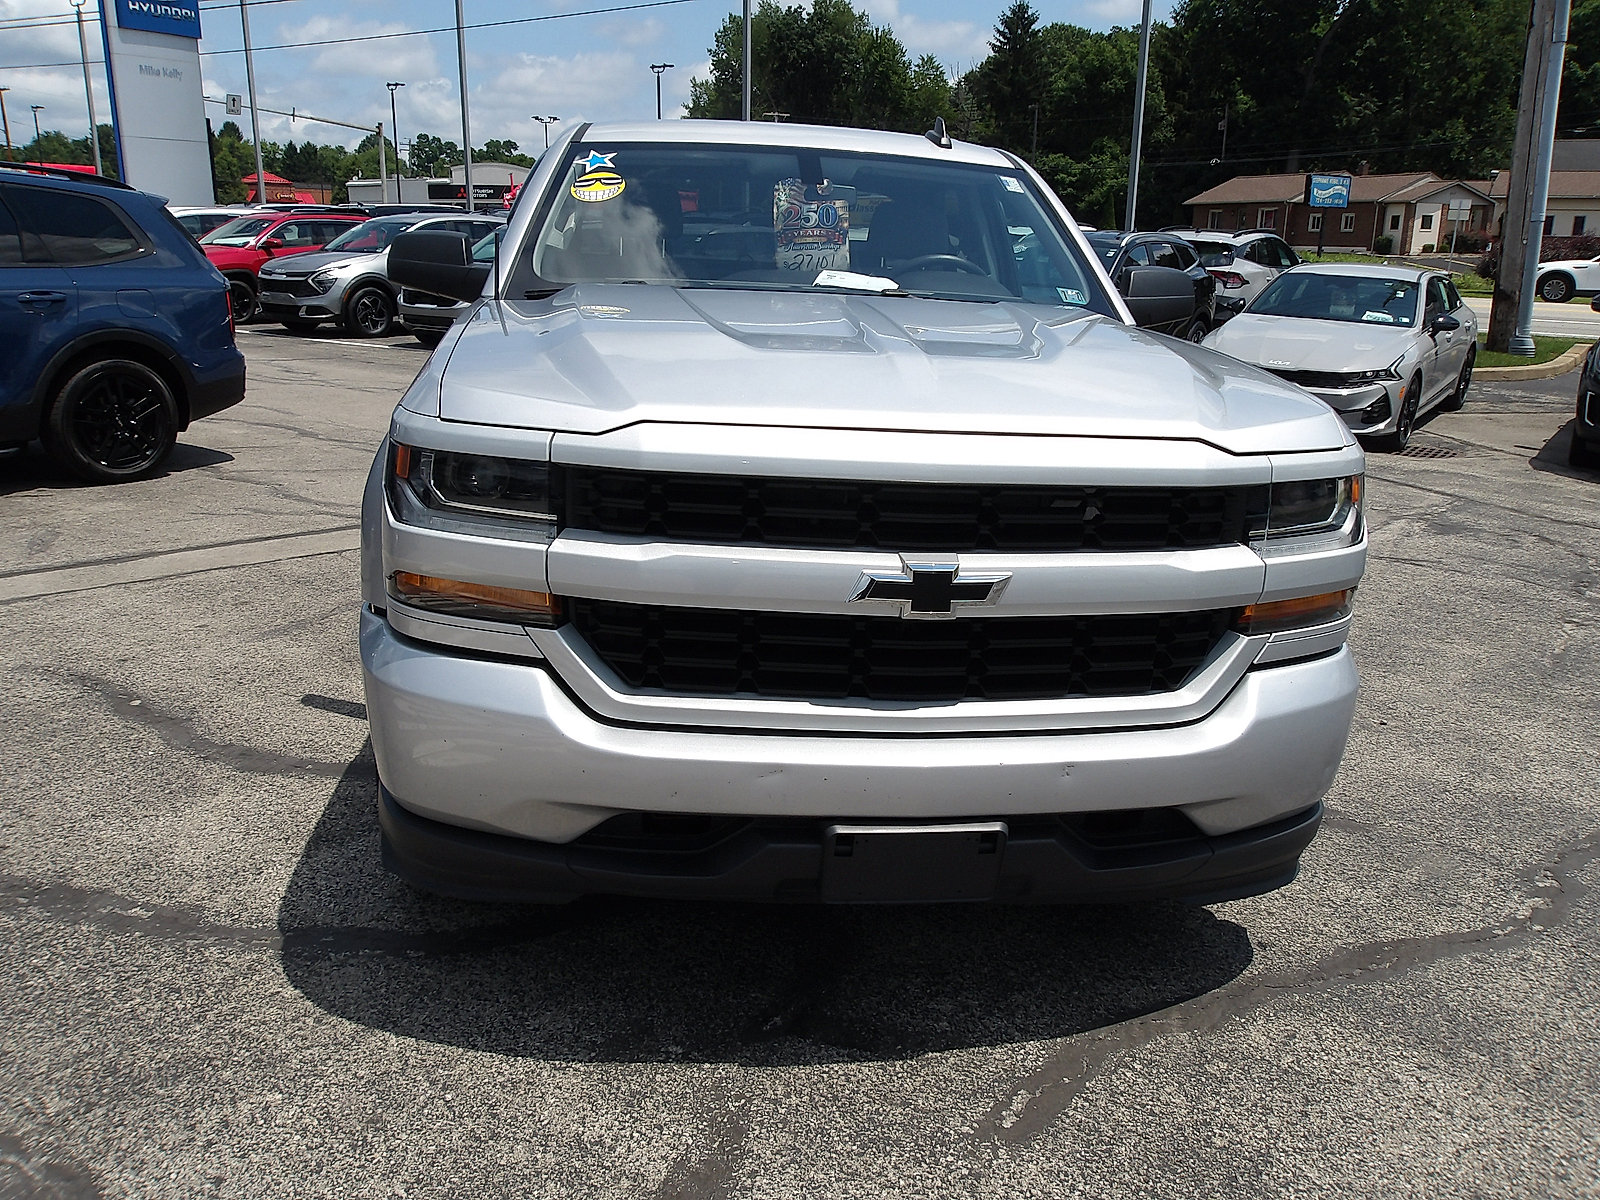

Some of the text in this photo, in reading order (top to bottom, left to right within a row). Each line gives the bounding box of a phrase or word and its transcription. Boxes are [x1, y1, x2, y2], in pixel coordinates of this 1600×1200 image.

[128, 1, 196, 19] HYUNDAI
[138, 64, 183, 81] Mike Kelly
[782, 203, 839, 229] 250
[793, 229, 828, 237] YEARS
